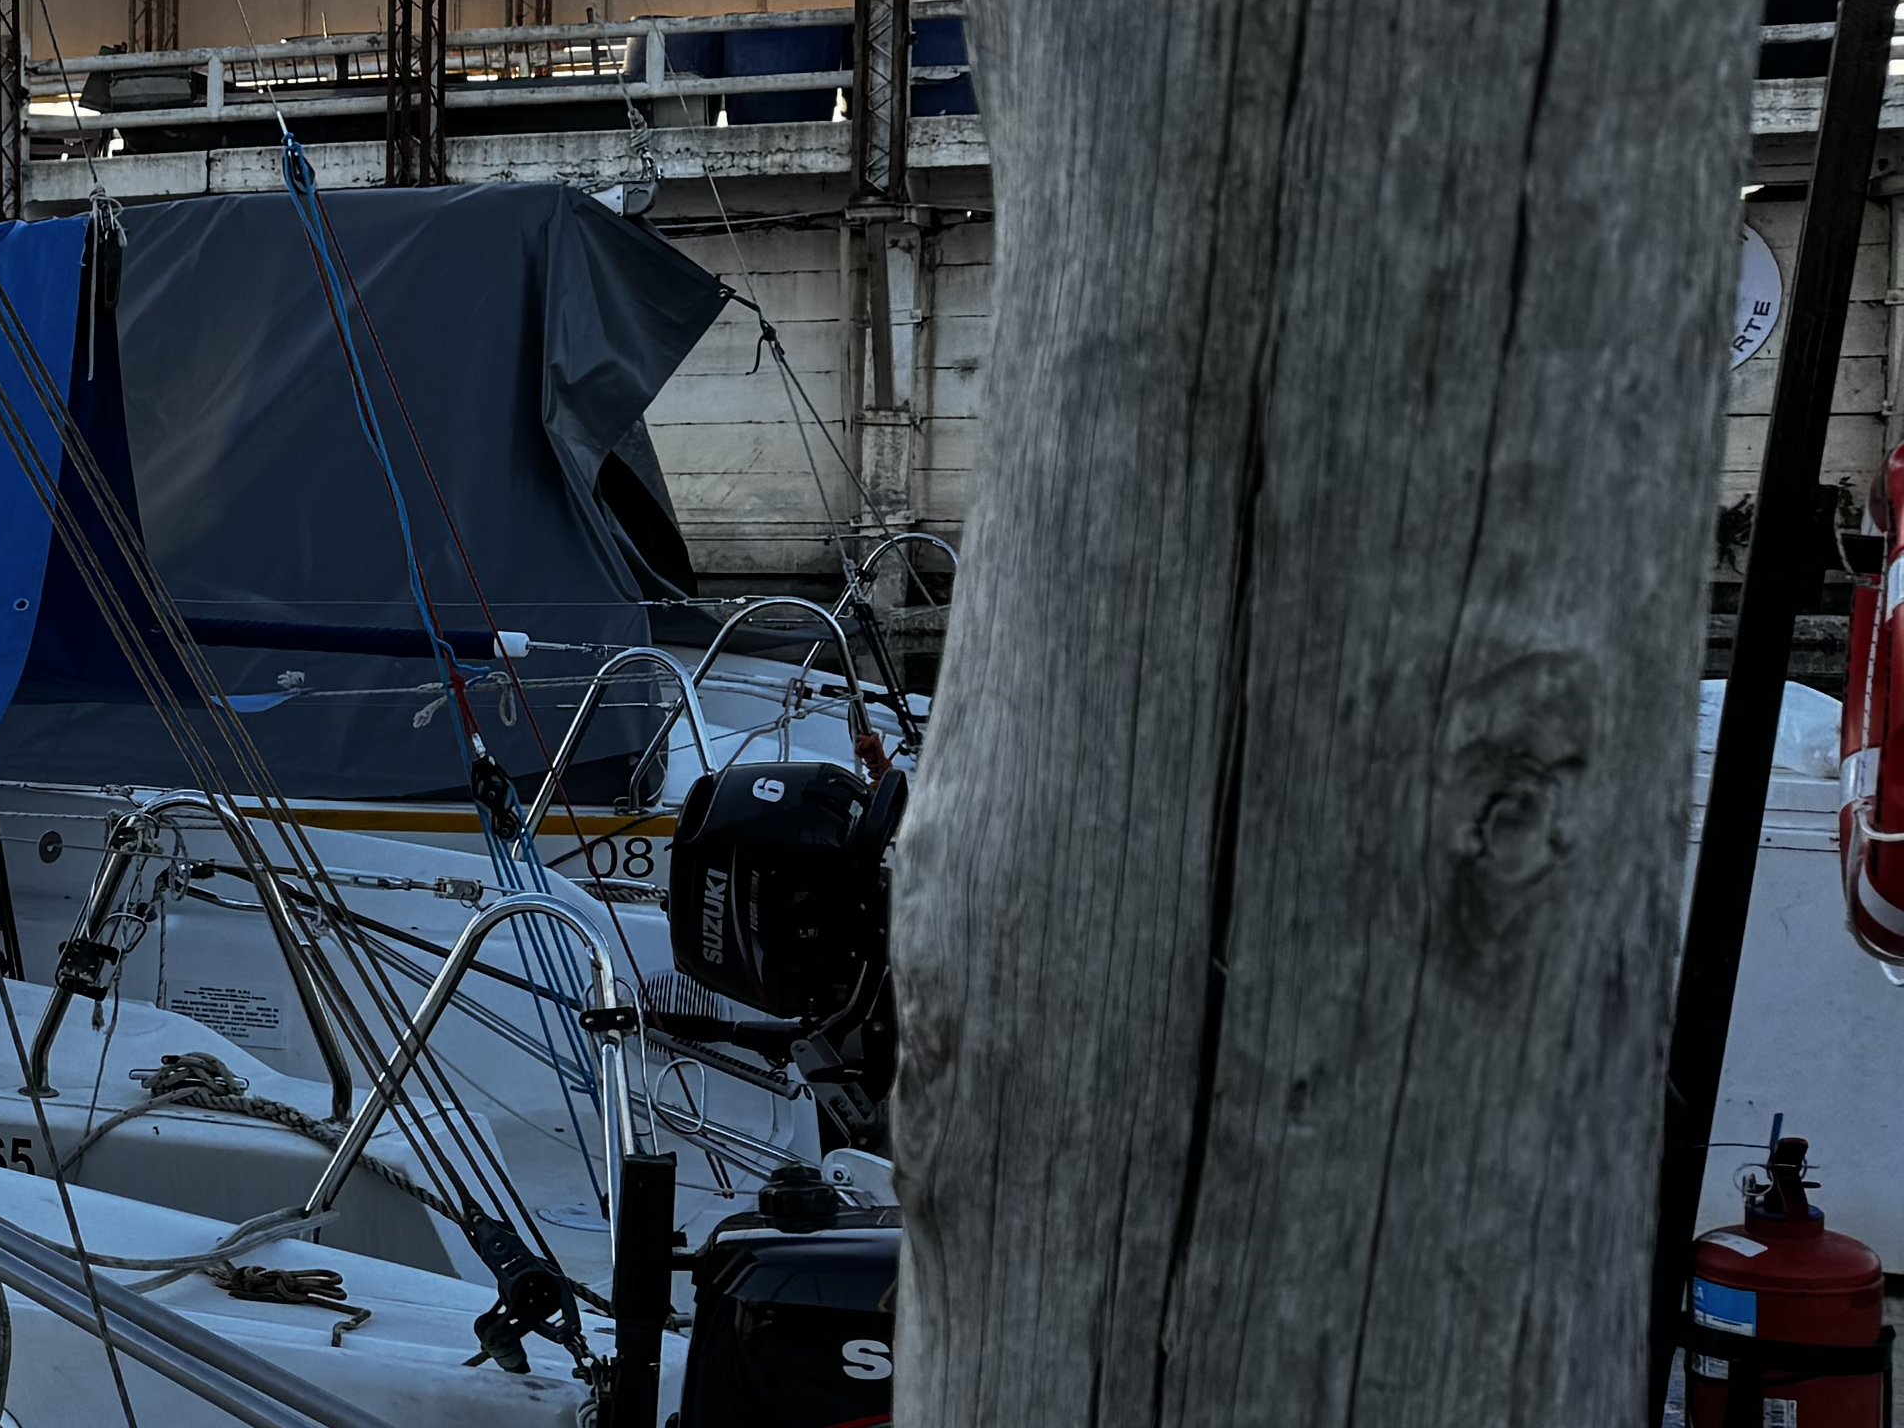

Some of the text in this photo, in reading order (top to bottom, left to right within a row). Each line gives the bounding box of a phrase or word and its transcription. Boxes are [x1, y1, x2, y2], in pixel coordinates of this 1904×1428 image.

[751, 776, 785, 804] 6
[586, 836, 674, 879] 08
[701, 867, 729, 965] SUZUKI
